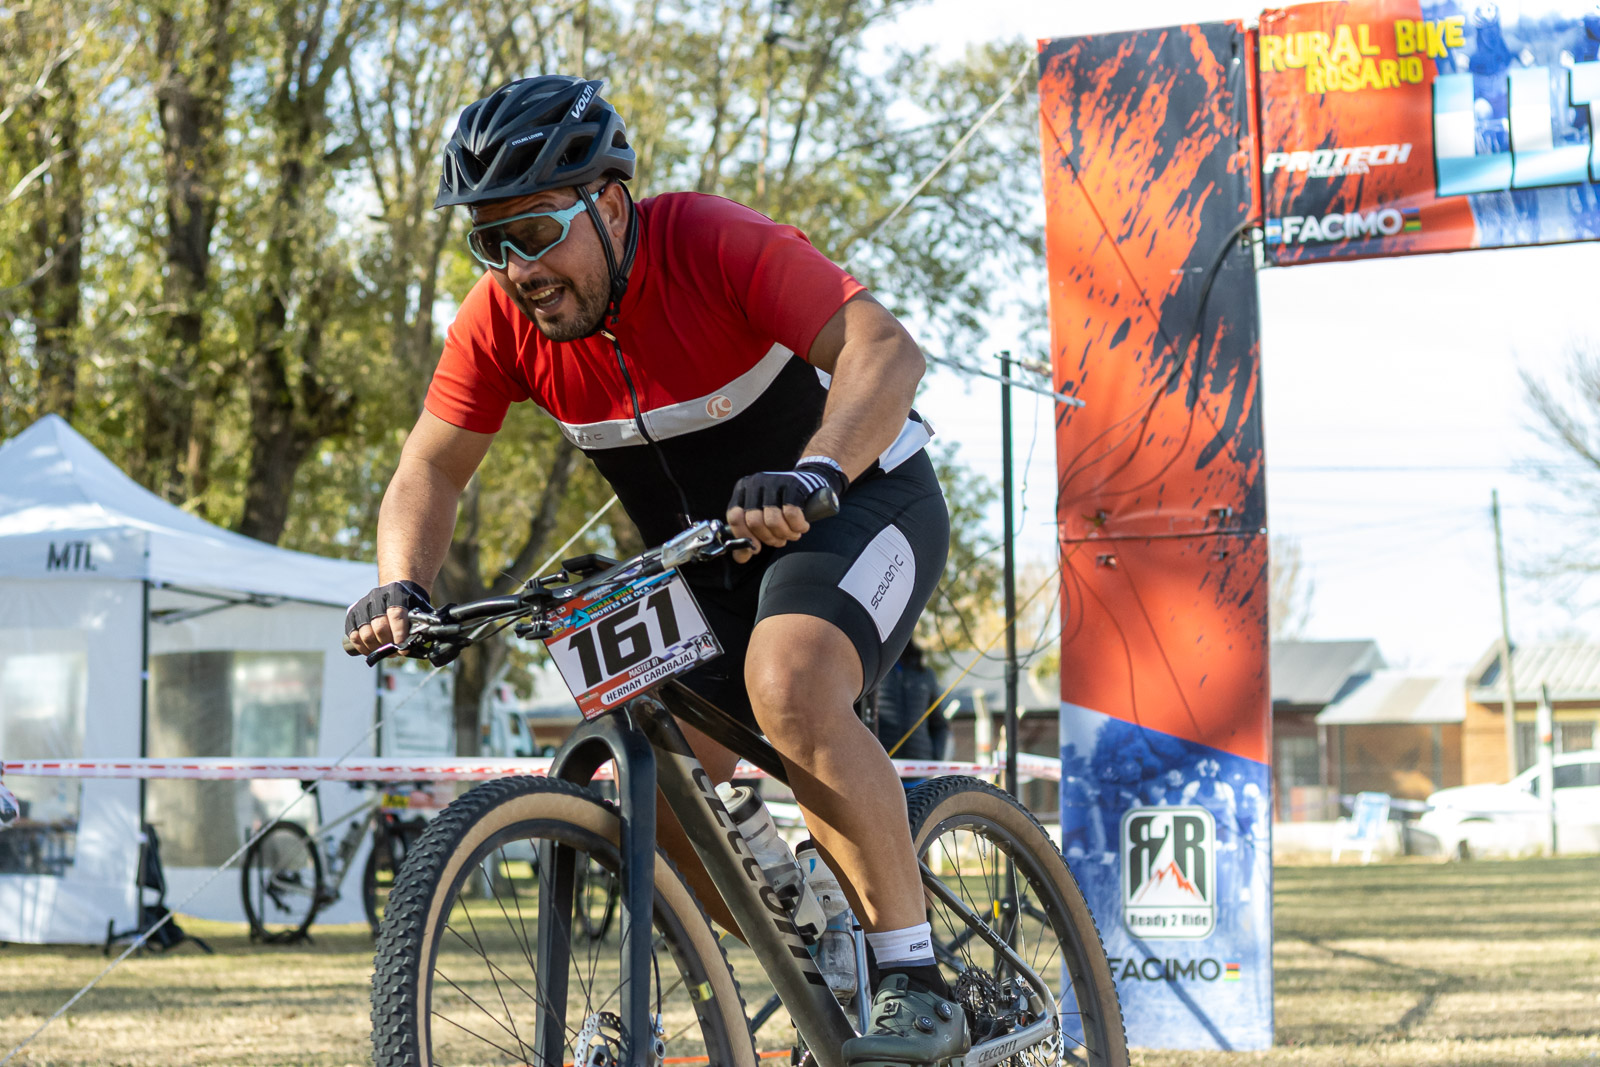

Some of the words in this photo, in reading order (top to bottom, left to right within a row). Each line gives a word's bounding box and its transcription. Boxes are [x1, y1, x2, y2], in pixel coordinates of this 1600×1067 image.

[1259, 24, 1380, 72] RURAL
[1394, 17, 1466, 58] BIKE
[1305, 56, 1424, 94] ROSARIO
[570, 84, 595, 119] VOLTA
[1262, 143, 1413, 174] PROTECH
[1281, 208, 1403, 244] FACIMO
[585, 597, 613, 615] RURAL
[613, 586, 634, 601] BIKE
[621, 594, 634, 604] DE
[633, 585, 651, 598] OCA
[568, 587, 681, 688] 161
[606, 679, 642, 703] HERNAN
[643, 652, 696, 684] CARABAJAL
[628, 660, 652, 678] MASTER
[1129, 913, 1167, 929] Ready
[1171, 914, 1179, 927] 2
[1182, 914, 1209, 927] Ride
[1109, 957, 1221, 982] FACIMO
[977, 1039, 1019, 1063] CECCOTTI
